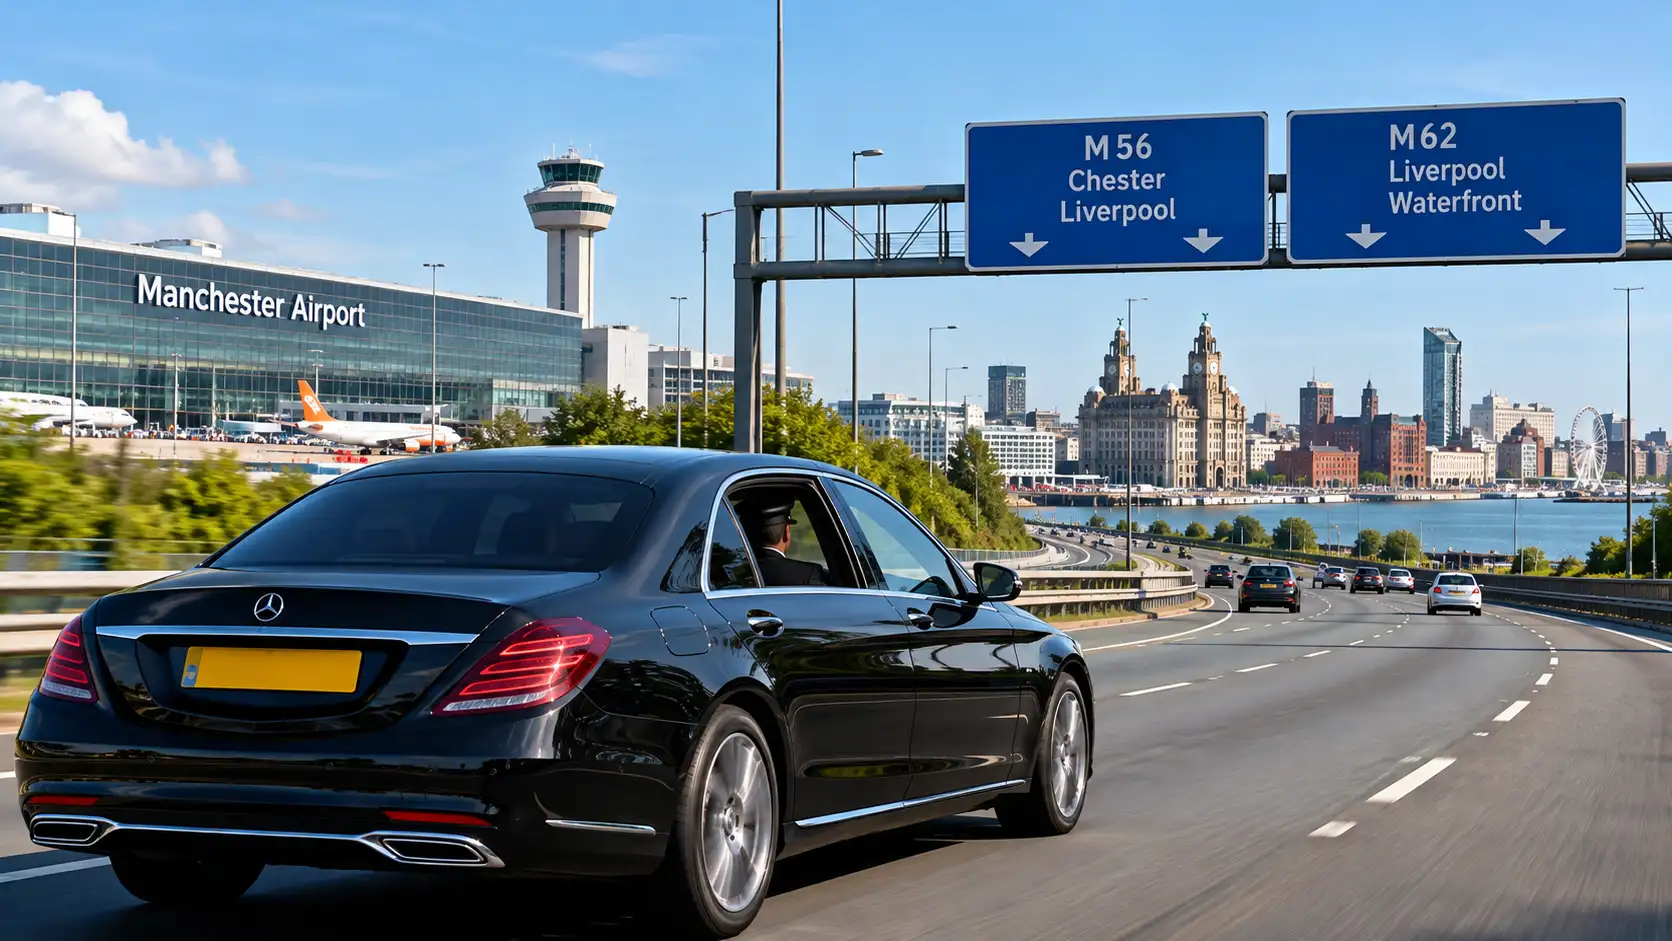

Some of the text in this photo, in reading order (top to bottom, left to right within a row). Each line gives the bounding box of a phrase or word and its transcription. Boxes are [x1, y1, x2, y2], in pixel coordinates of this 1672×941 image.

[1068, 168, 1166, 192] Chester
[1389, 156, 1506, 187] Liverpool
[1061, 197, 1177, 227] Liverpool
[1388, 189, 1523, 214] Waterfront
[137, 273, 367, 331] Manchester Airport
